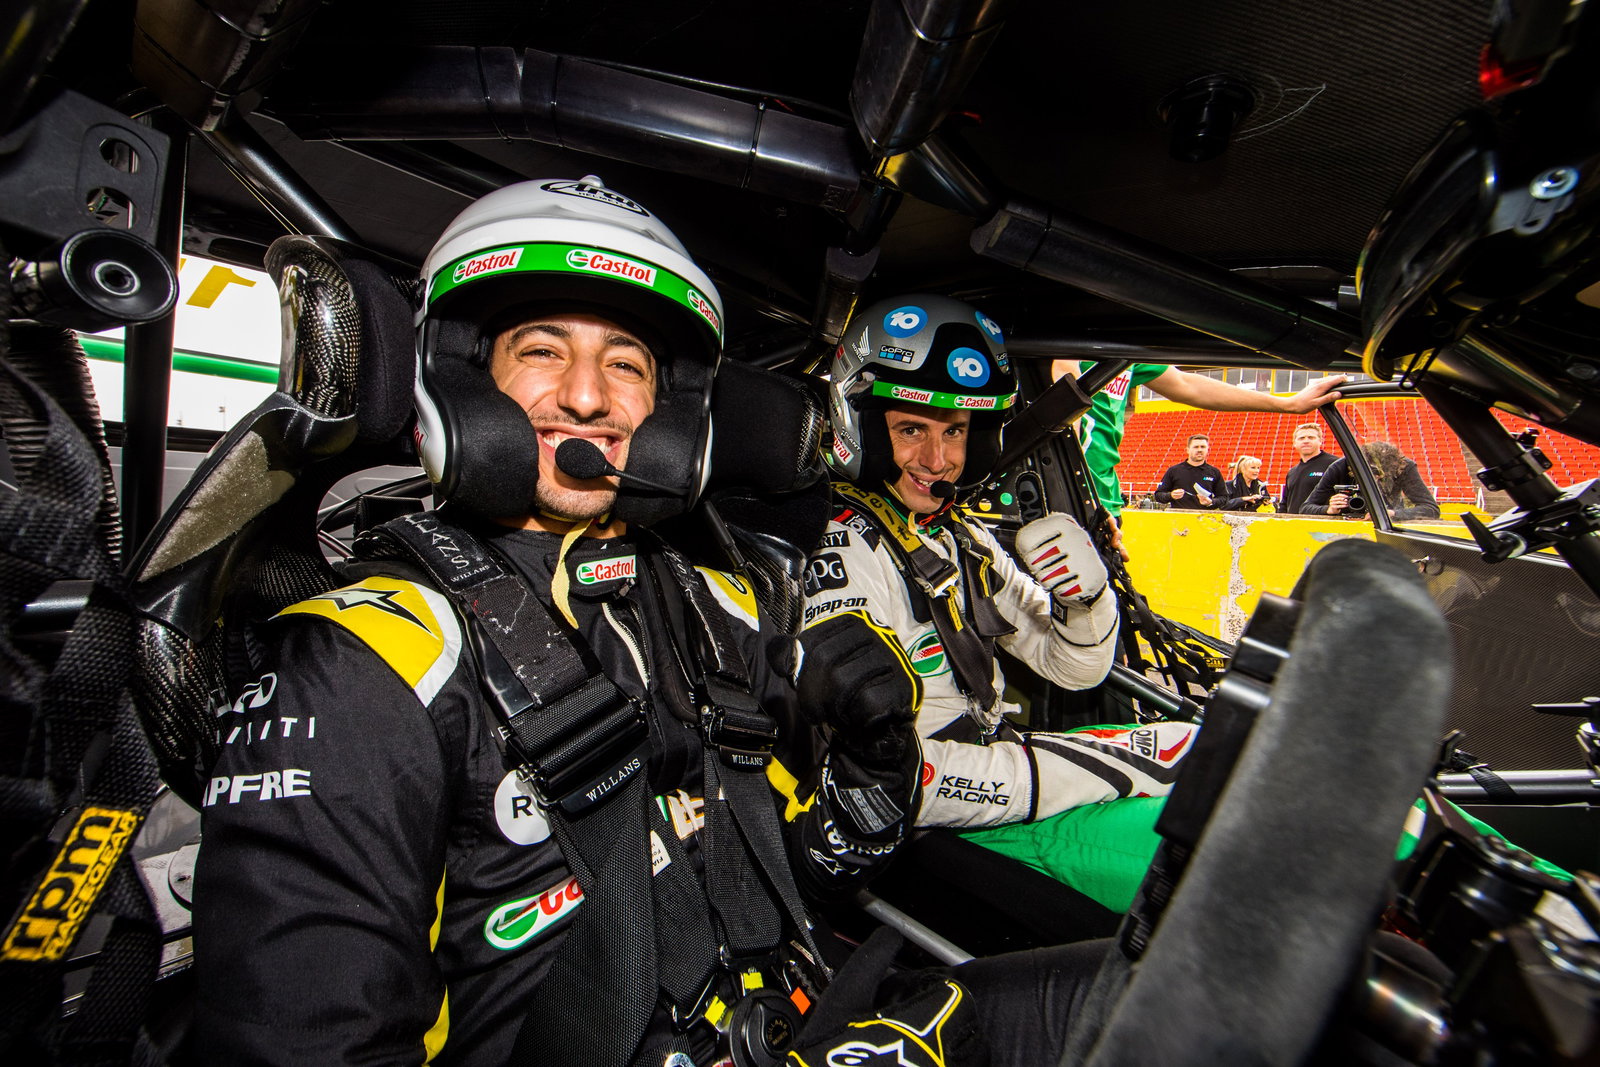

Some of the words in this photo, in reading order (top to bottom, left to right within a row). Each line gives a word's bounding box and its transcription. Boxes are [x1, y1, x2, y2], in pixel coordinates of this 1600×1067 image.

[465, 251, 517, 276] Castrol
[590, 254, 651, 283] Castrol
[890, 312, 920, 330] 10
[981, 317, 1001, 336] 10
[881, 345, 913, 357] GoPro
[952, 357, 983, 378] 10
[900, 388, 931, 403] Castrol
[964, 397, 995, 408] Castrol
[450, 564, 490, 582] WILLANS
[594, 558, 635, 580] Castrol
[803, 559, 845, 590] PPG
[805, 597, 868, 623] Snap-on
[731, 754, 764, 766] WILLANS
[202, 768, 312, 807] PFRE
[585, 757, 641, 802] WILLANS
[940, 774, 1005, 793] KELLY
[936, 787, 1011, 807] RACING
[12, 814, 115, 949] rpm
